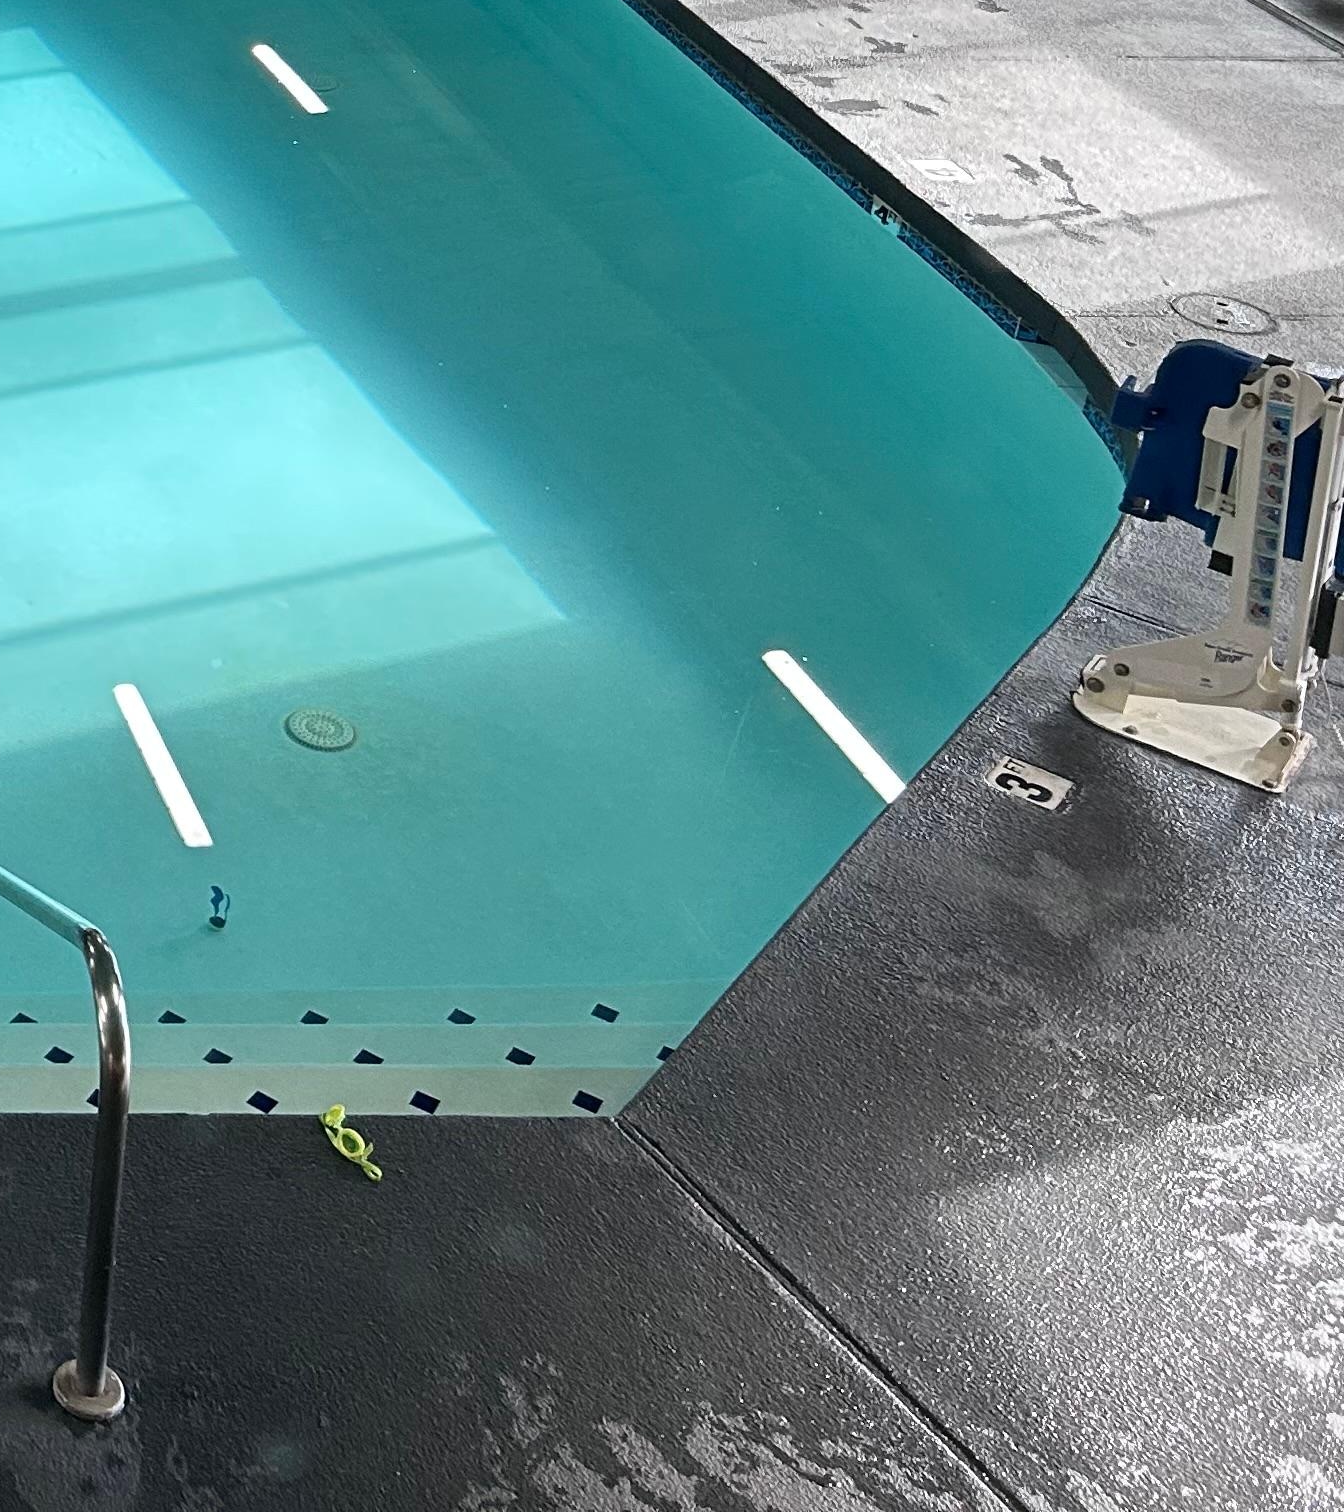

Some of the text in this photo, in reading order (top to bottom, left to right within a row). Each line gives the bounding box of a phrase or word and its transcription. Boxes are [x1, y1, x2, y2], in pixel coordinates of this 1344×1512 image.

[874, 204, 889, 226] 4
[1214, 649, 1244, 664] Ranger
[995, 772, 1054, 803] 3
